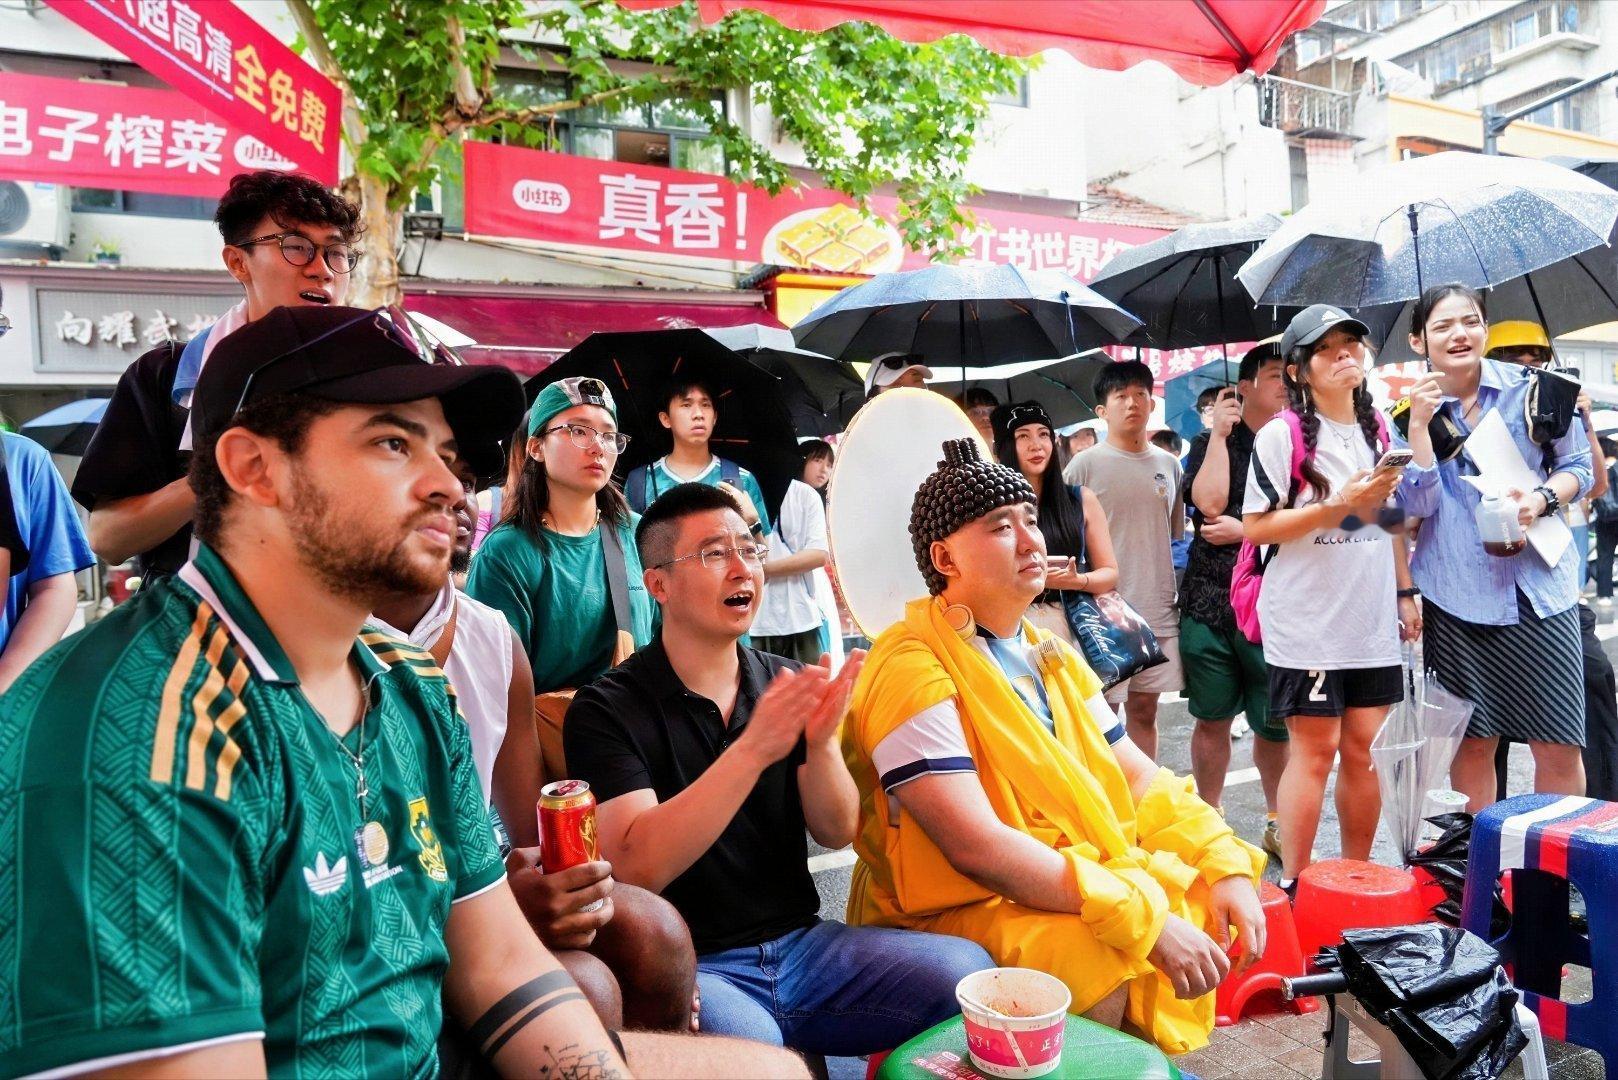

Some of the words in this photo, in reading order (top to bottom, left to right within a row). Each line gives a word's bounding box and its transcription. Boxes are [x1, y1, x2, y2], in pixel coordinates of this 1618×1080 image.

[109, 0, 327, 154] 超高清全免费
[521, 187, 562, 207] 小红书
[599, 173, 747, 250] 真香!
[1308, 669, 1327, 701] 2
